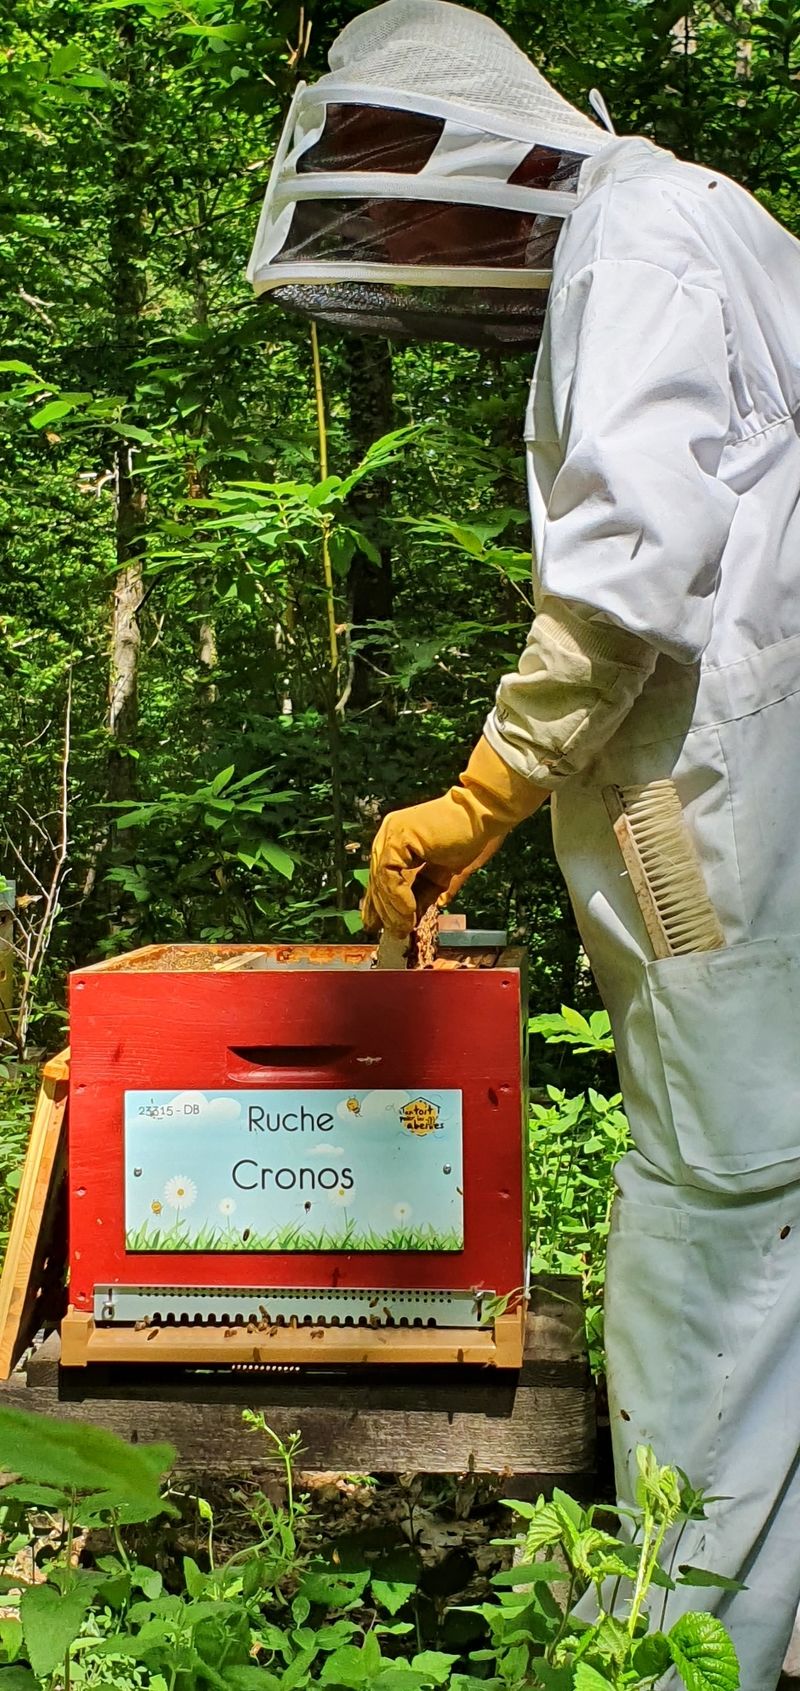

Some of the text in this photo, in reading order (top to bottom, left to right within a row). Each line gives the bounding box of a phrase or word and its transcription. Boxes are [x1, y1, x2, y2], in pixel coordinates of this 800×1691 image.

[183, 1104, 200, 1115] DB
[248, 1105, 335, 1132] Ruche
[232, 1159, 354, 1190] Cronos
